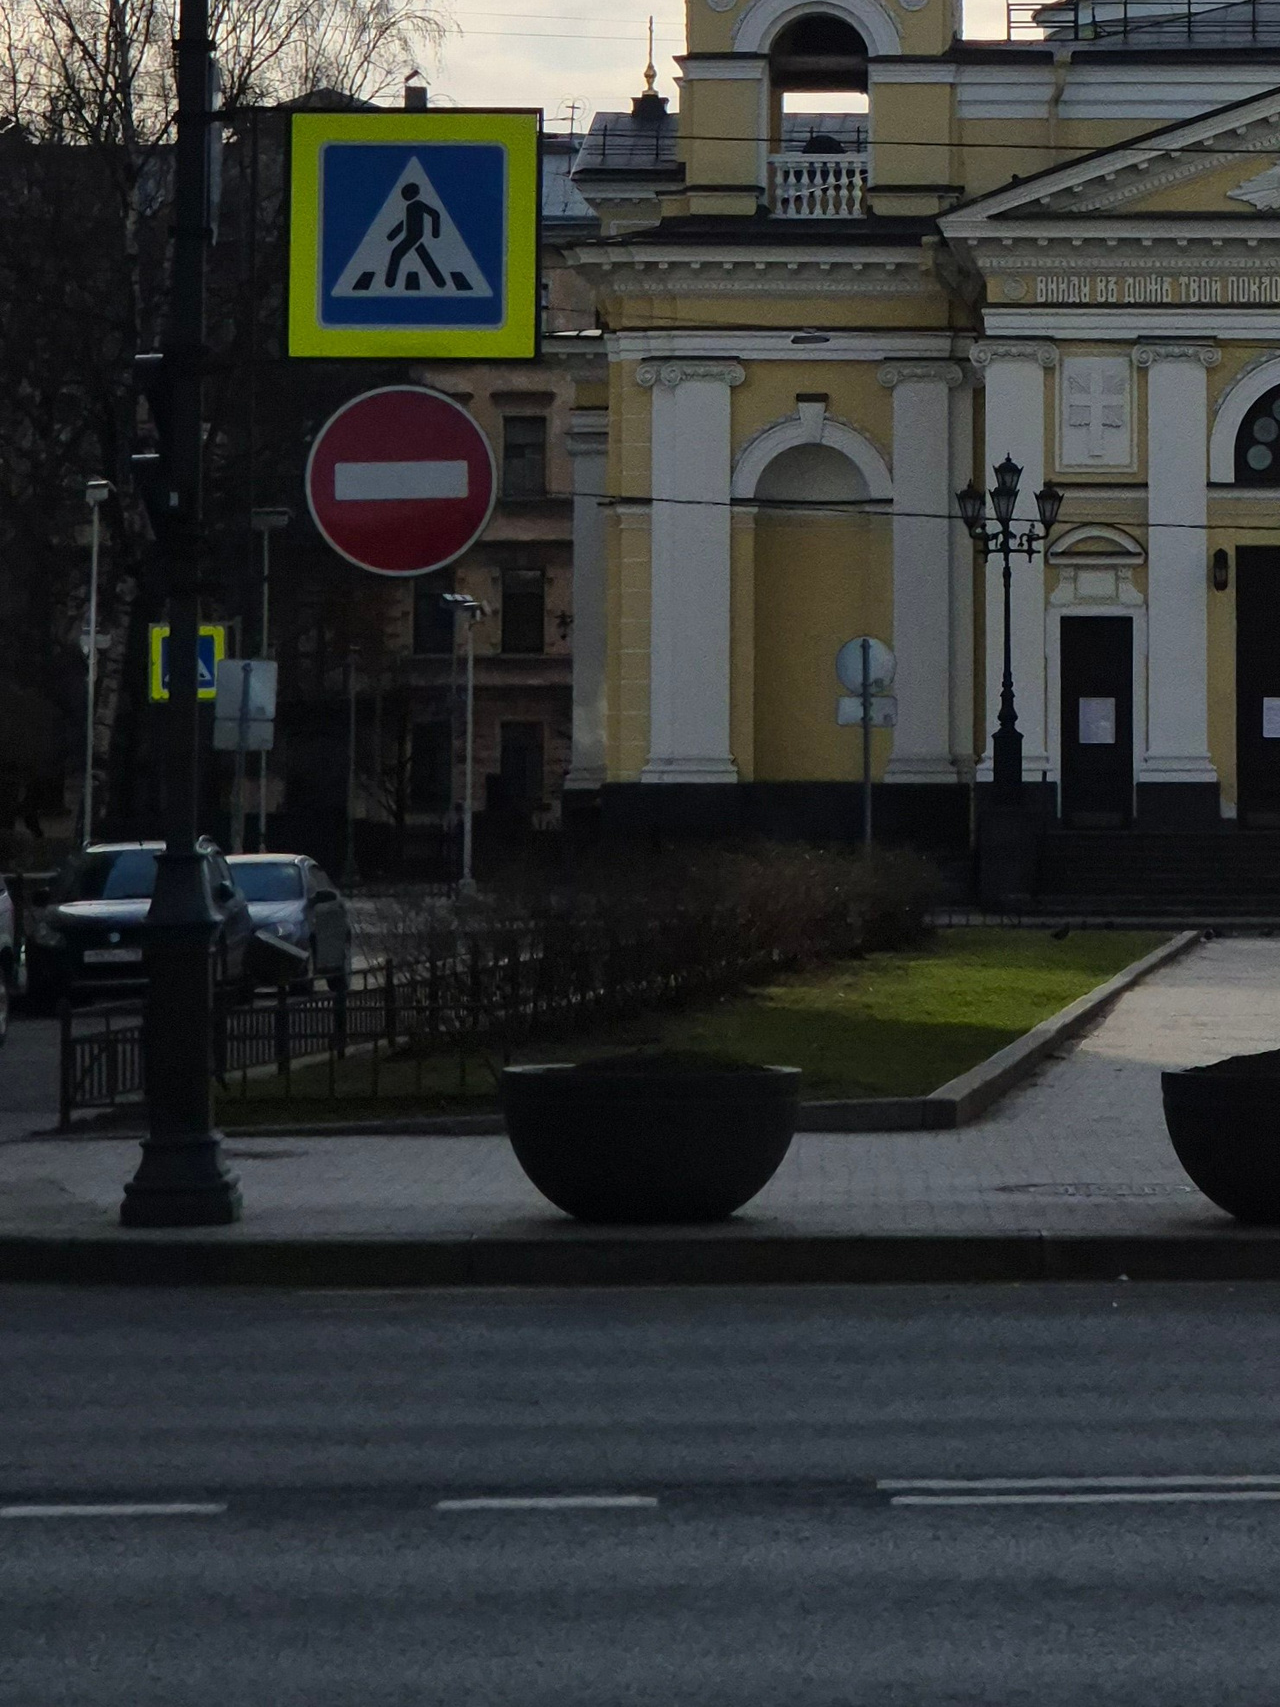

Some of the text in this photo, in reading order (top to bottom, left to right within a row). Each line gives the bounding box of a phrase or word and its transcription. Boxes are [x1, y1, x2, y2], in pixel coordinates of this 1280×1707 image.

[1037, 276, 1090, 302] ВНИДУ
[1097, 276, 1117, 302] ВЪ
[1125, 274, 1172, 303] ДОМЪ
[1179, 276, 1221, 302] ТВОЙ
